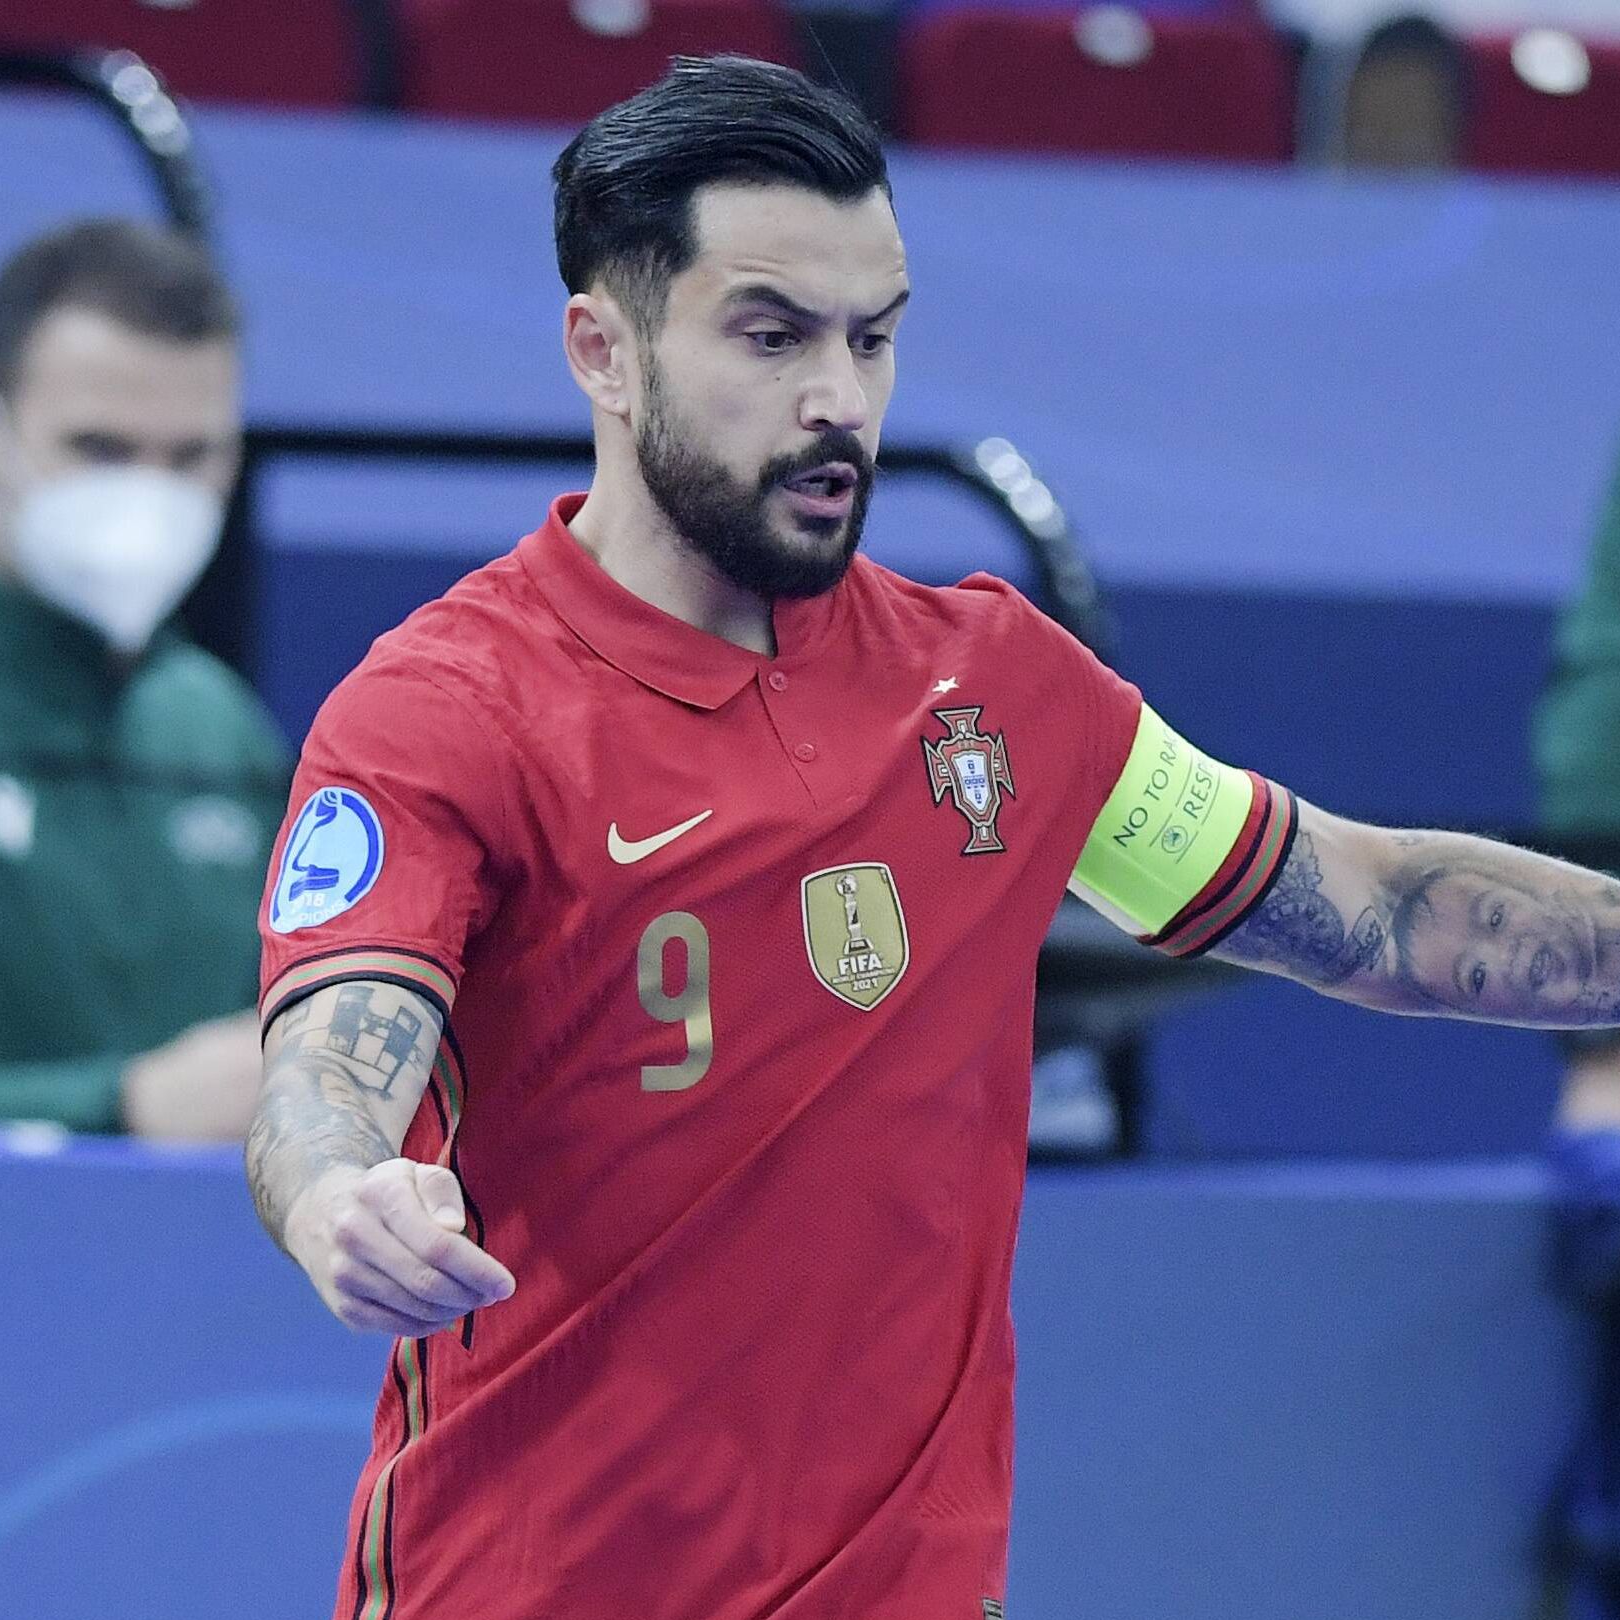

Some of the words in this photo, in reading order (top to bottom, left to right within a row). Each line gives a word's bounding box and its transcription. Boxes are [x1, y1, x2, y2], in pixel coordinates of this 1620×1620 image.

[1113, 807, 1148, 848] NO
[1143, 769, 1169, 801] TO
[637, 911, 713, 1091] 9
[838, 953, 883, 976] FIFA
